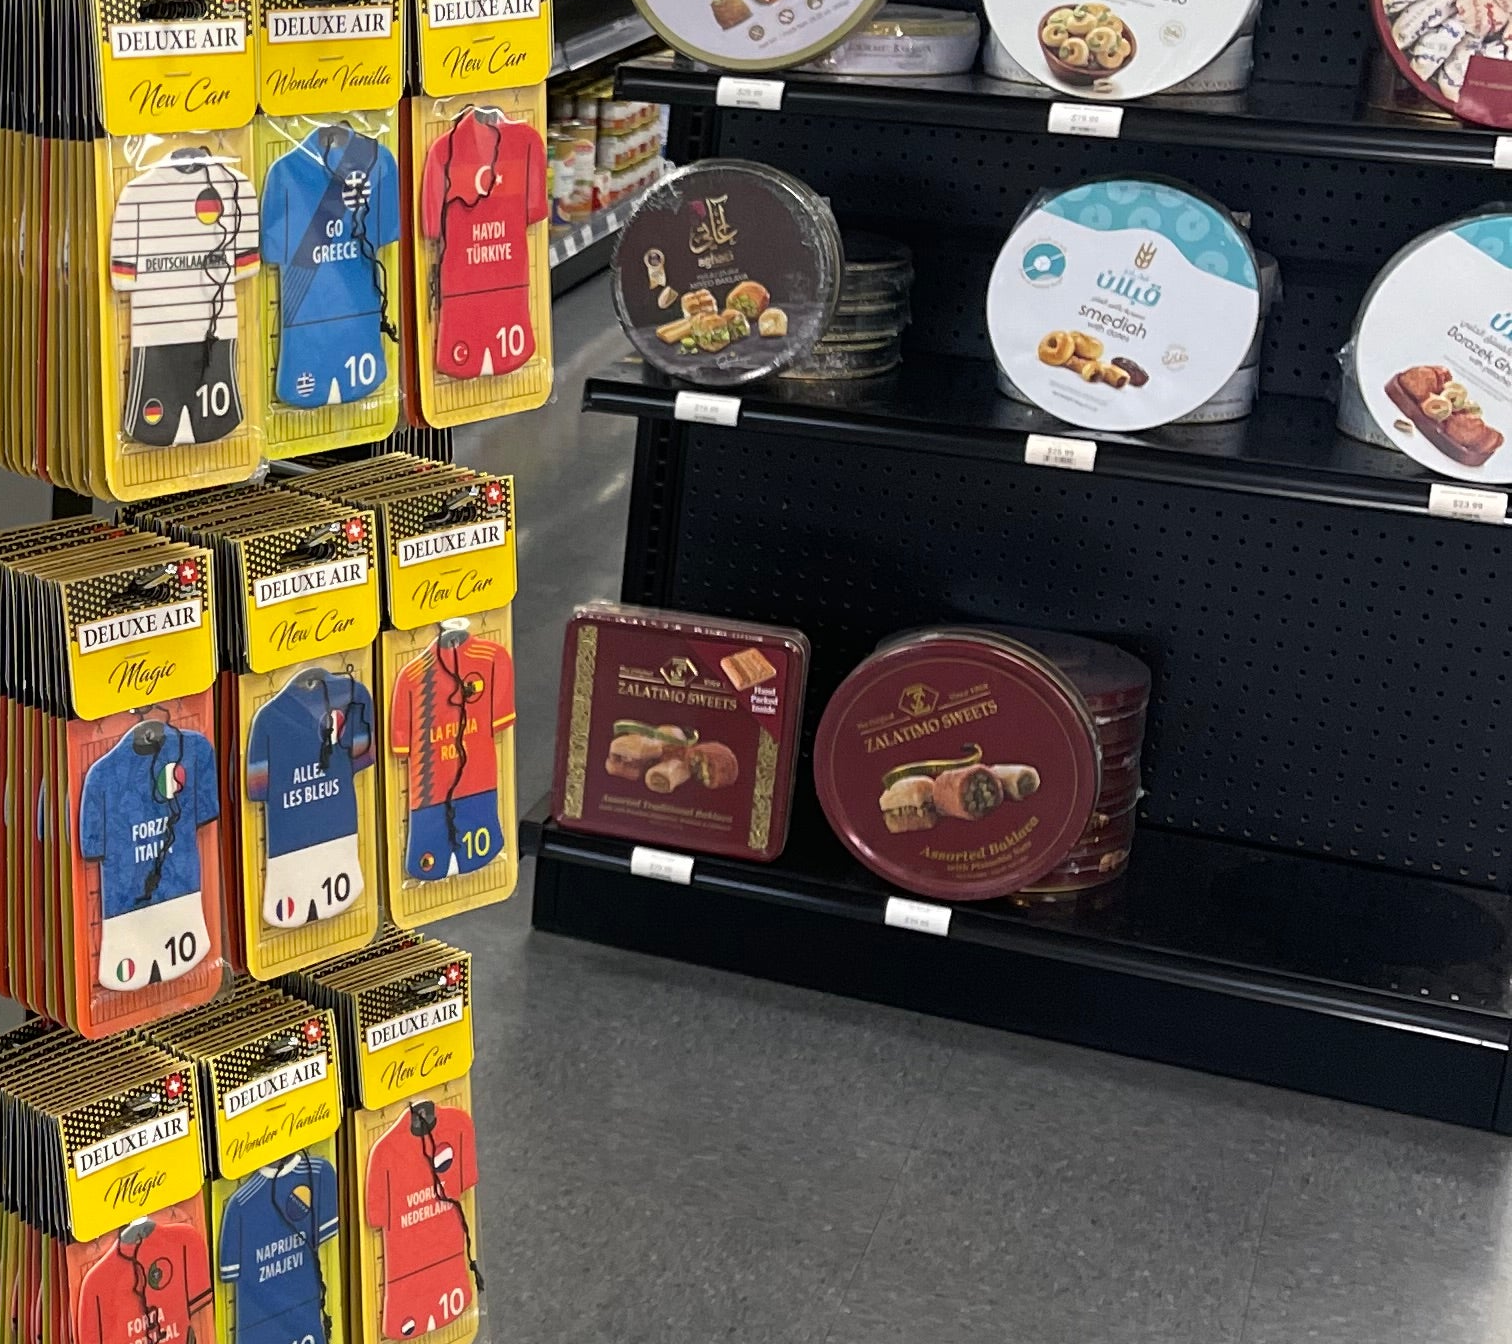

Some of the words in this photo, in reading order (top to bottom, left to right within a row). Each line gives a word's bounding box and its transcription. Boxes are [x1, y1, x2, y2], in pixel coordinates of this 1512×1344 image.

[433, 0, 497, 23] DELUXE
[117, 29, 196, 53] DELUXE
[200, 25, 239, 49] AIR
[443, 47, 487, 78] New
[490, 48, 527, 72] Car
[265, 70, 329, 97] Wonder
[332, 65, 392, 92] Vanilla
[129, 80, 180, 117] New
[185, 84, 231, 109] Car
[325, 219, 344, 239] GO
[472, 220, 507, 242] HAYDI
[312, 240, 358, 264] GREECE
[466, 240, 512, 265] TÜRKIYE
[1078, 304, 1147, 340] smediah
[495, 324, 526, 357] 10
[344, 353, 376, 387] 10
[195, 381, 230, 418] 10
[402, 537, 465, 563] DELUXE
[468, 525, 501, 550] AIR
[83, 614, 158, 649] DELUXE
[161, 606, 196, 633] AIR
[269, 618, 317, 653] New
[320, 607, 356, 636] Car
[107, 659, 177, 696] Magic
[617, 683, 685, 704] ZALATIMO
[688, 693, 737, 711] SWEETS
[864, 719, 940, 754] ZALATIMO
[942, 699, 998, 729] SWEETS
[293, 762, 328, 786] ALLEZ
[283, 789, 303, 809] LES
[304, 778, 341, 806] BLEUS
[131, 815, 170, 843] FORZA
[461, 828, 491, 859] 10
[163, 931, 197, 965] 10
[399, 1197, 454, 1228] NEDERLAND
[255, 1231, 307, 1264] NAPRIJED
[258, 1253, 305, 1283] ZMAJEVI
[438, 1287, 466, 1320] 10
